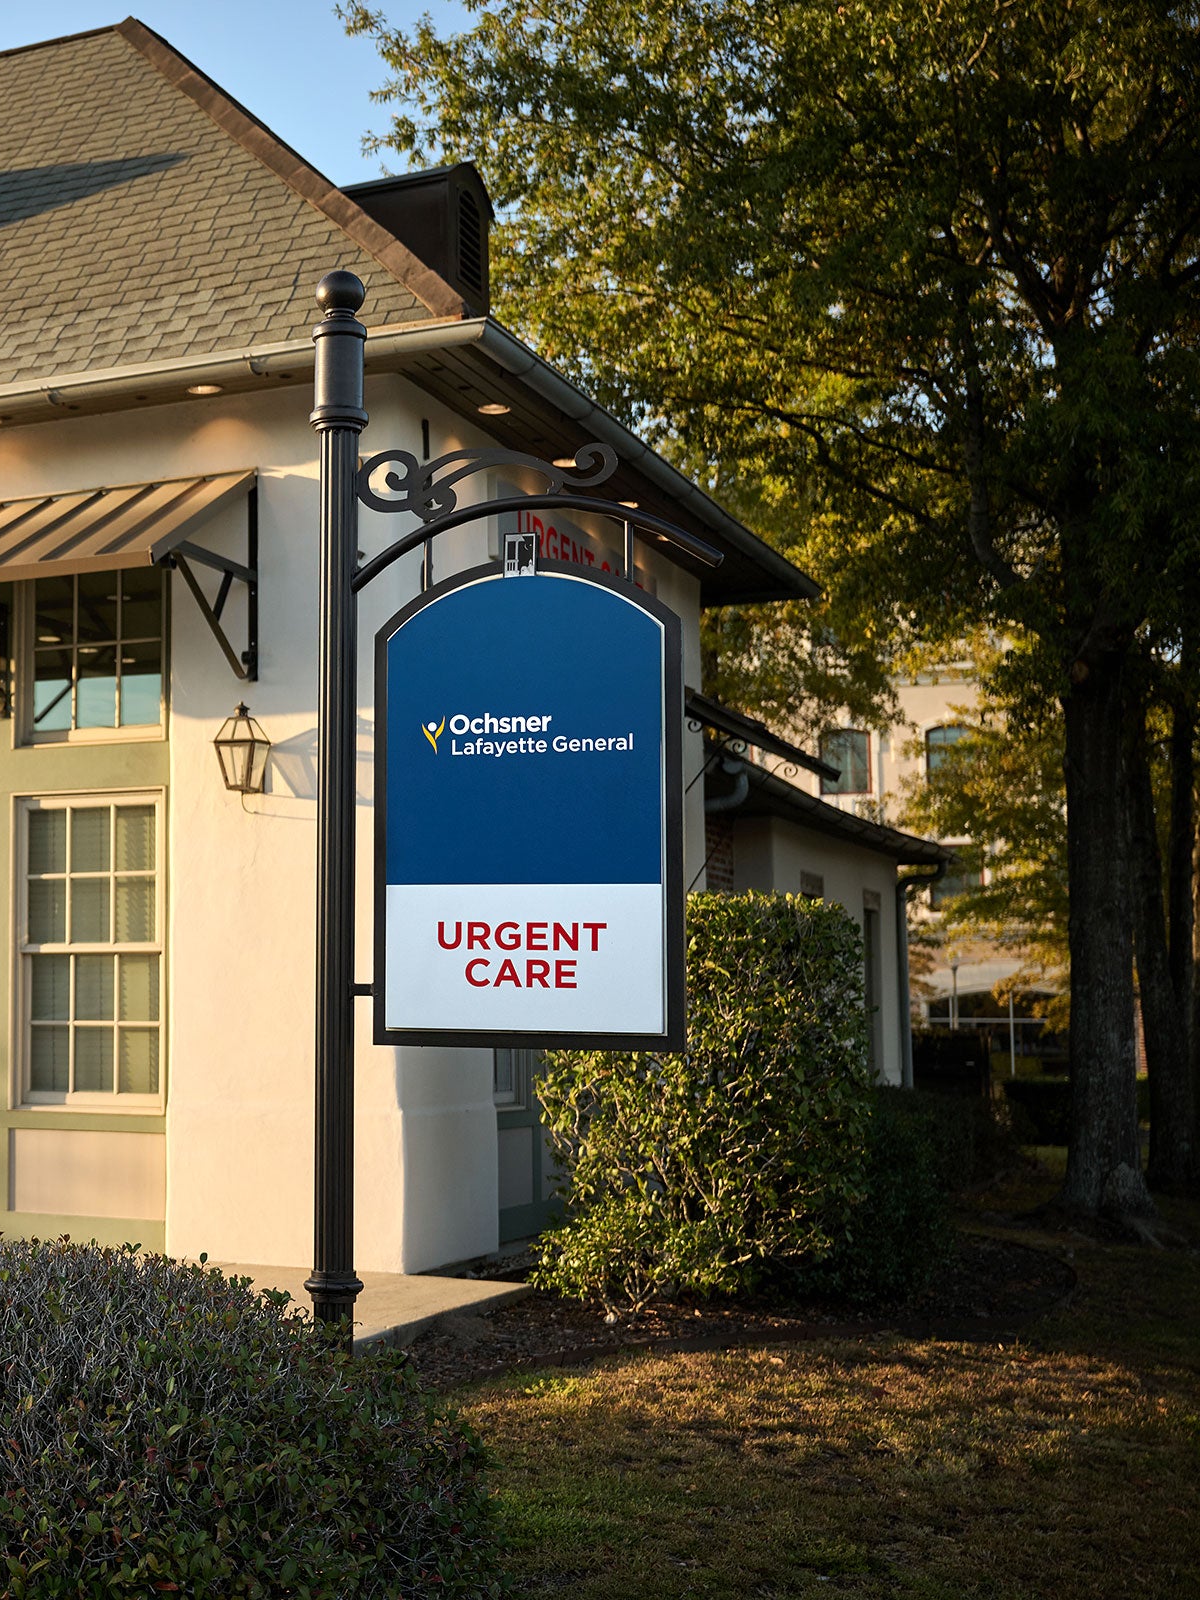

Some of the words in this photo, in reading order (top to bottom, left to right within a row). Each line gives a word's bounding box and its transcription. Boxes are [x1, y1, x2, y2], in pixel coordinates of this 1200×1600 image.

[449, 712, 552, 736] Ochsner
[451, 737, 548, 758] Lafayette
[552, 733, 634, 753] General
[437, 921, 607, 952] URGENT
[464, 957, 578, 989] CARE
